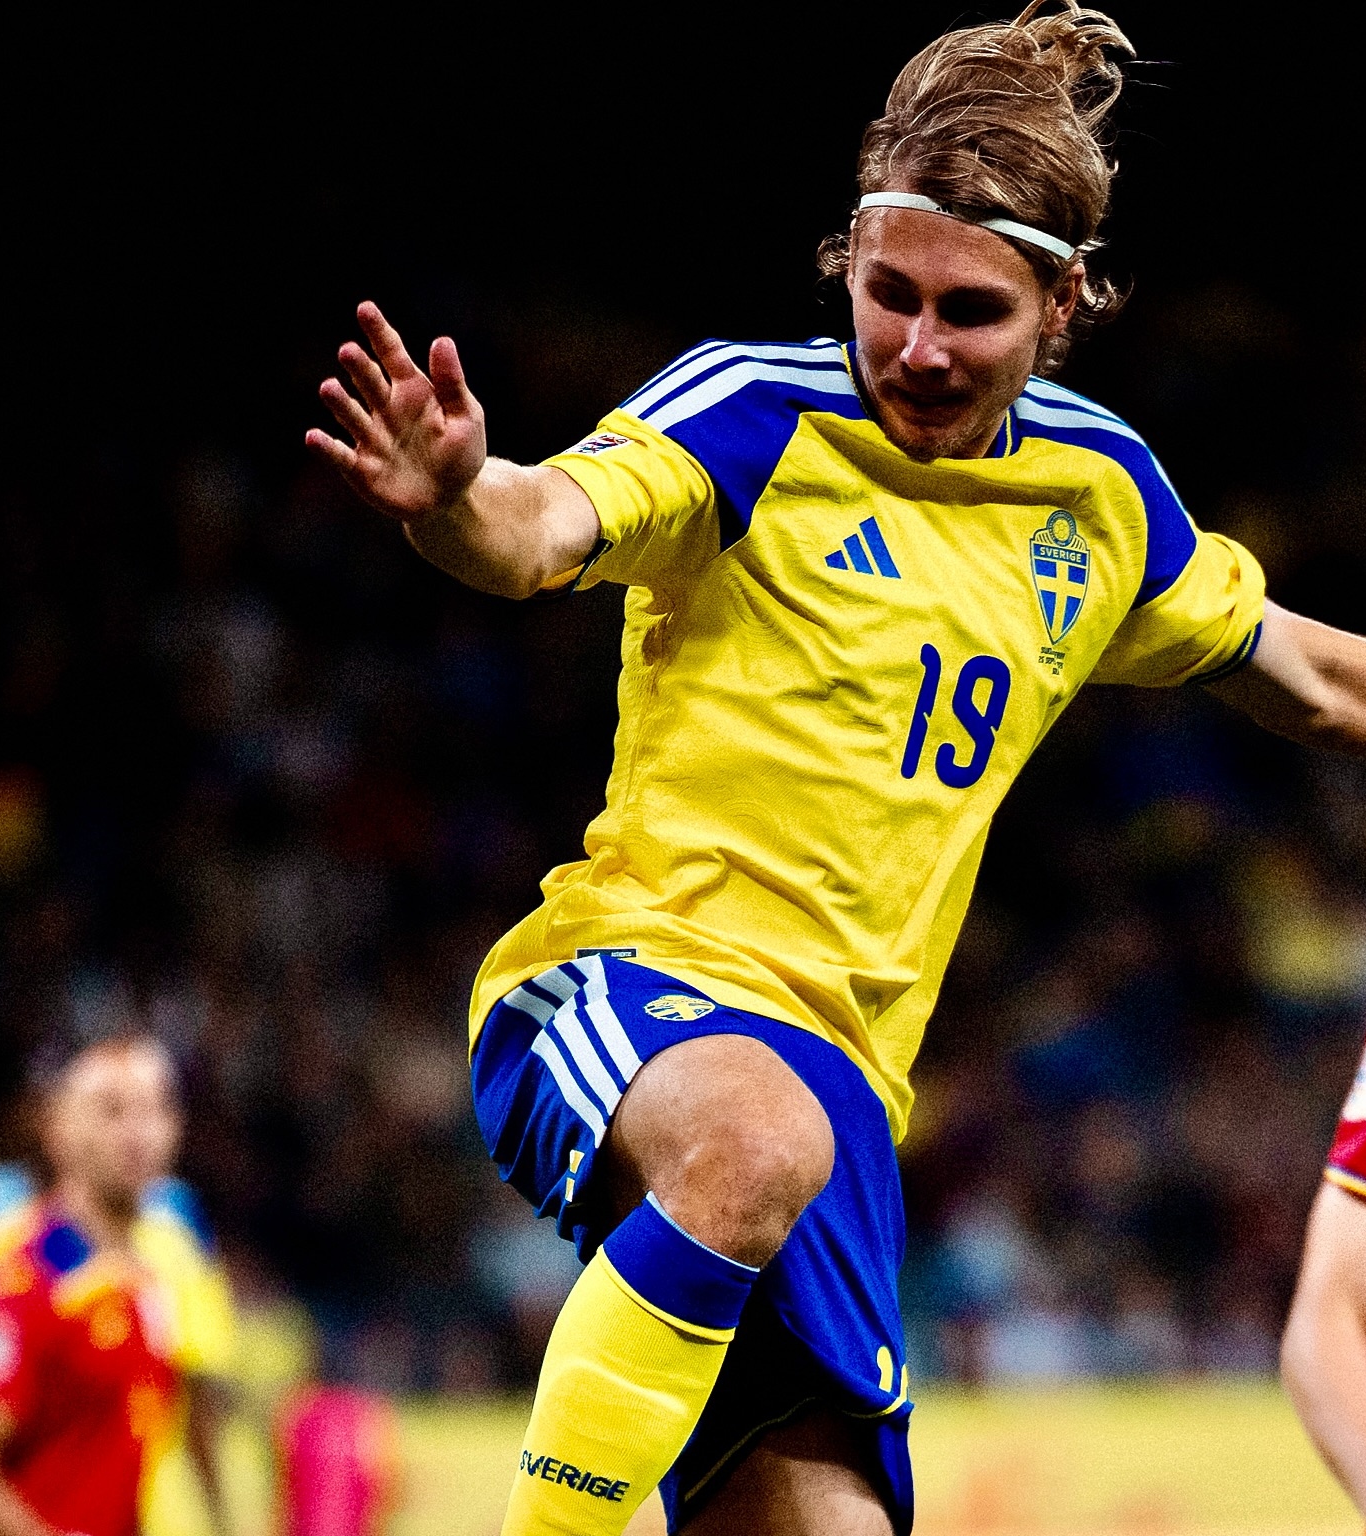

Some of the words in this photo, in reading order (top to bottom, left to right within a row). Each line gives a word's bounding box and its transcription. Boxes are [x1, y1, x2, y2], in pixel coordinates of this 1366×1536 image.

[1039, 546, 1082, 563] SVERIGE
[900, 643, 1012, 789] 19
[520, 1449, 631, 1503] SVERIGE
